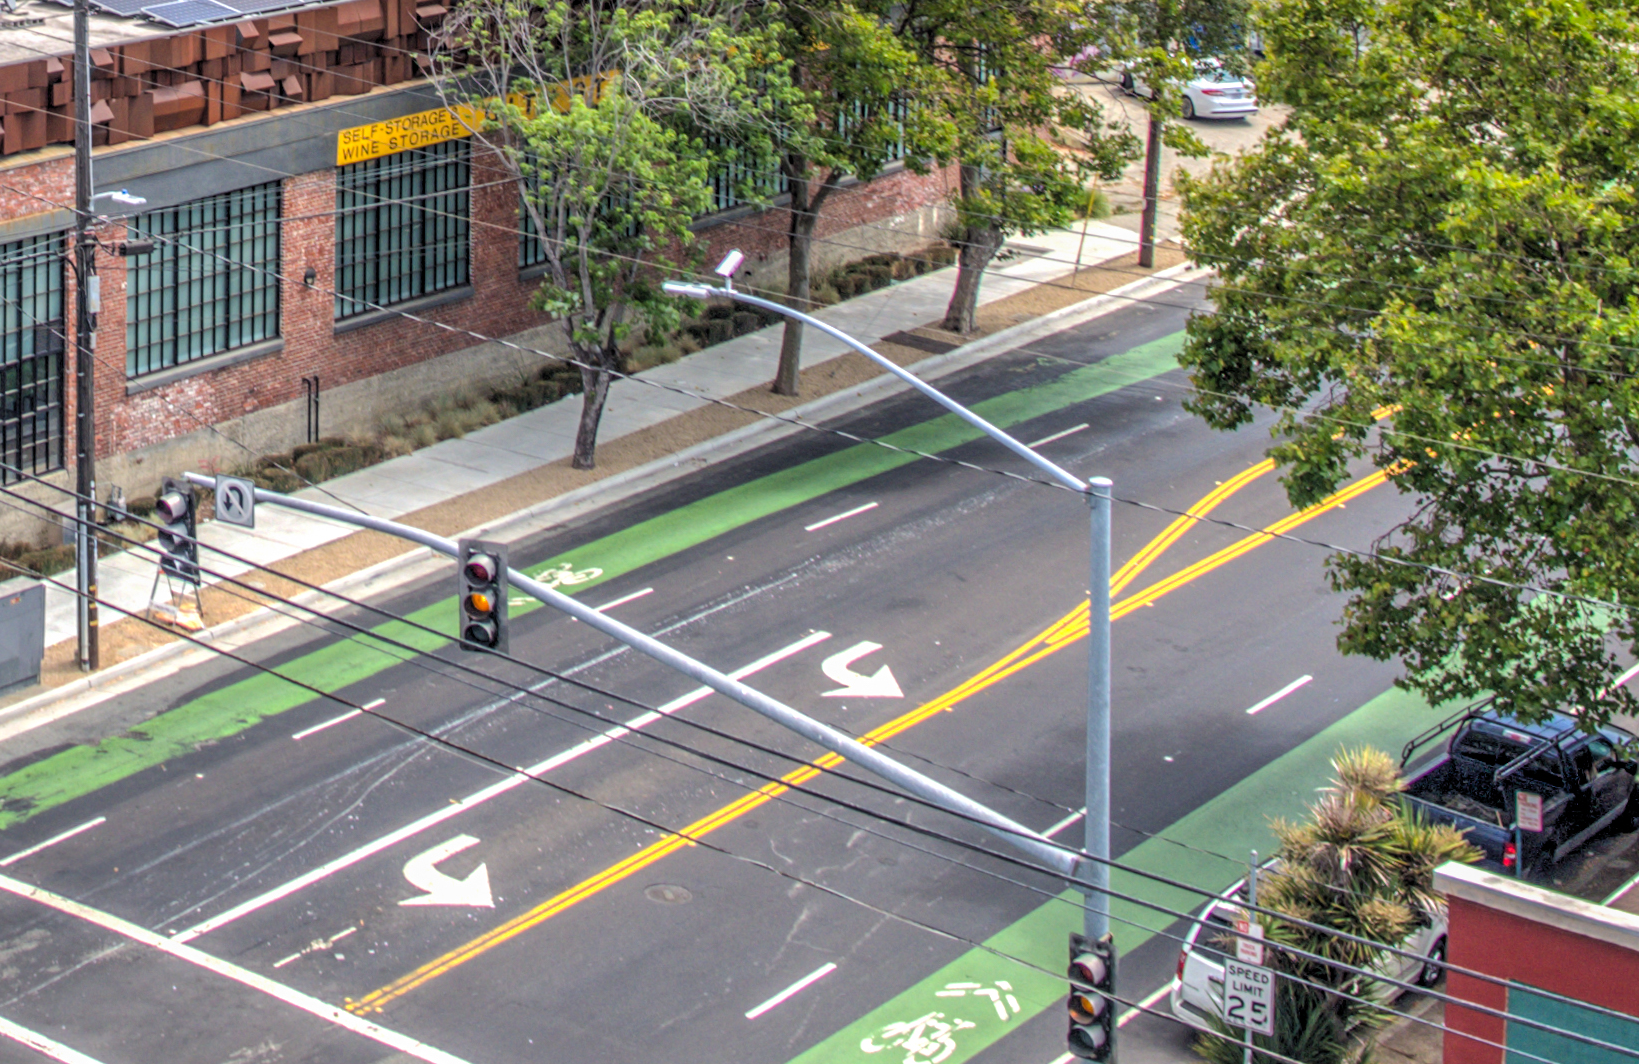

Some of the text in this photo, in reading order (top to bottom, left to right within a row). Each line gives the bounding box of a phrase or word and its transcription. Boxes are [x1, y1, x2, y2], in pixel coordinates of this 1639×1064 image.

[342, 109, 447, 145] SELF-STORAGE
[342, 123, 460, 160] WINE STORAGE
[1228, 965, 1269, 984] SPEED
[1232, 981, 1263, 997] LIMIT
[1227, 995, 1267, 1025] 25
